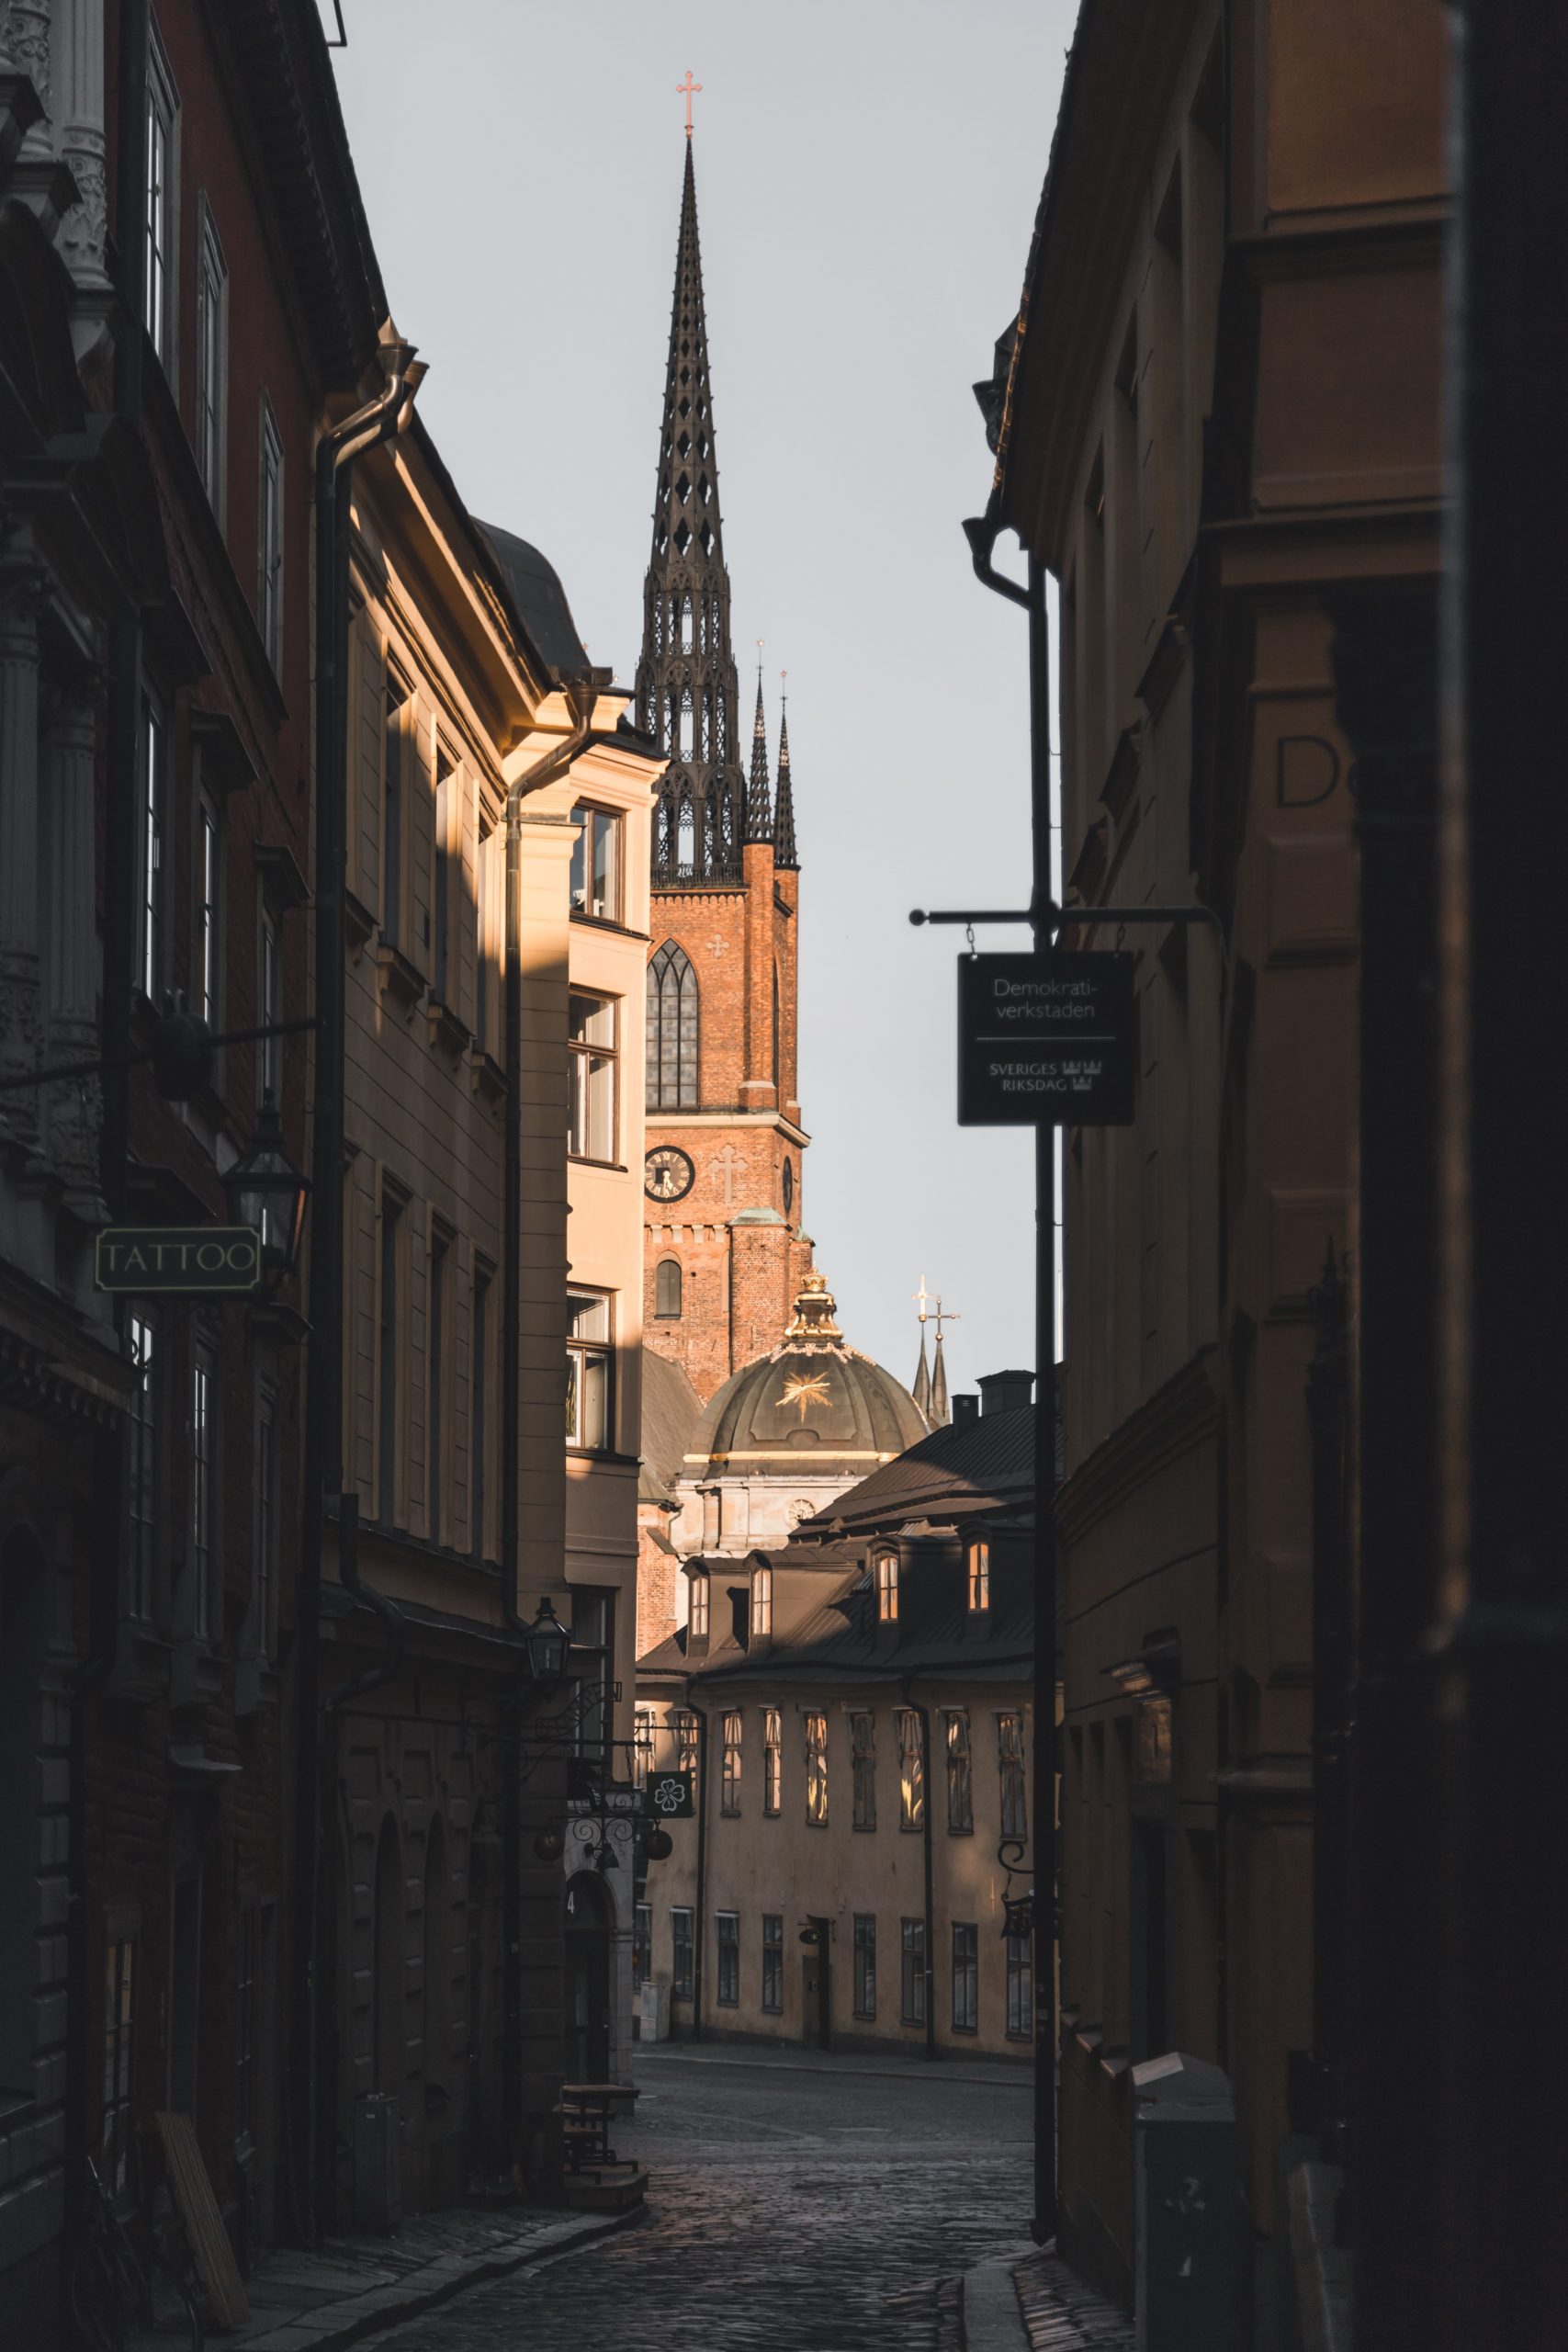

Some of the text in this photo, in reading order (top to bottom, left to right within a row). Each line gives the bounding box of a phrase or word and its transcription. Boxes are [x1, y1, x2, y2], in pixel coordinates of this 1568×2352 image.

[1277, 736, 1340, 808] D
[994, 978, 1099, 997] Demokrati-
[996, 1001, 1095, 1018] verkstaden
[990, 1062, 1057, 1075] SVERIGES
[1002, 1079, 1067, 1091] RIKSDAG
[100, 1242, 255, 1272] TATTOO
